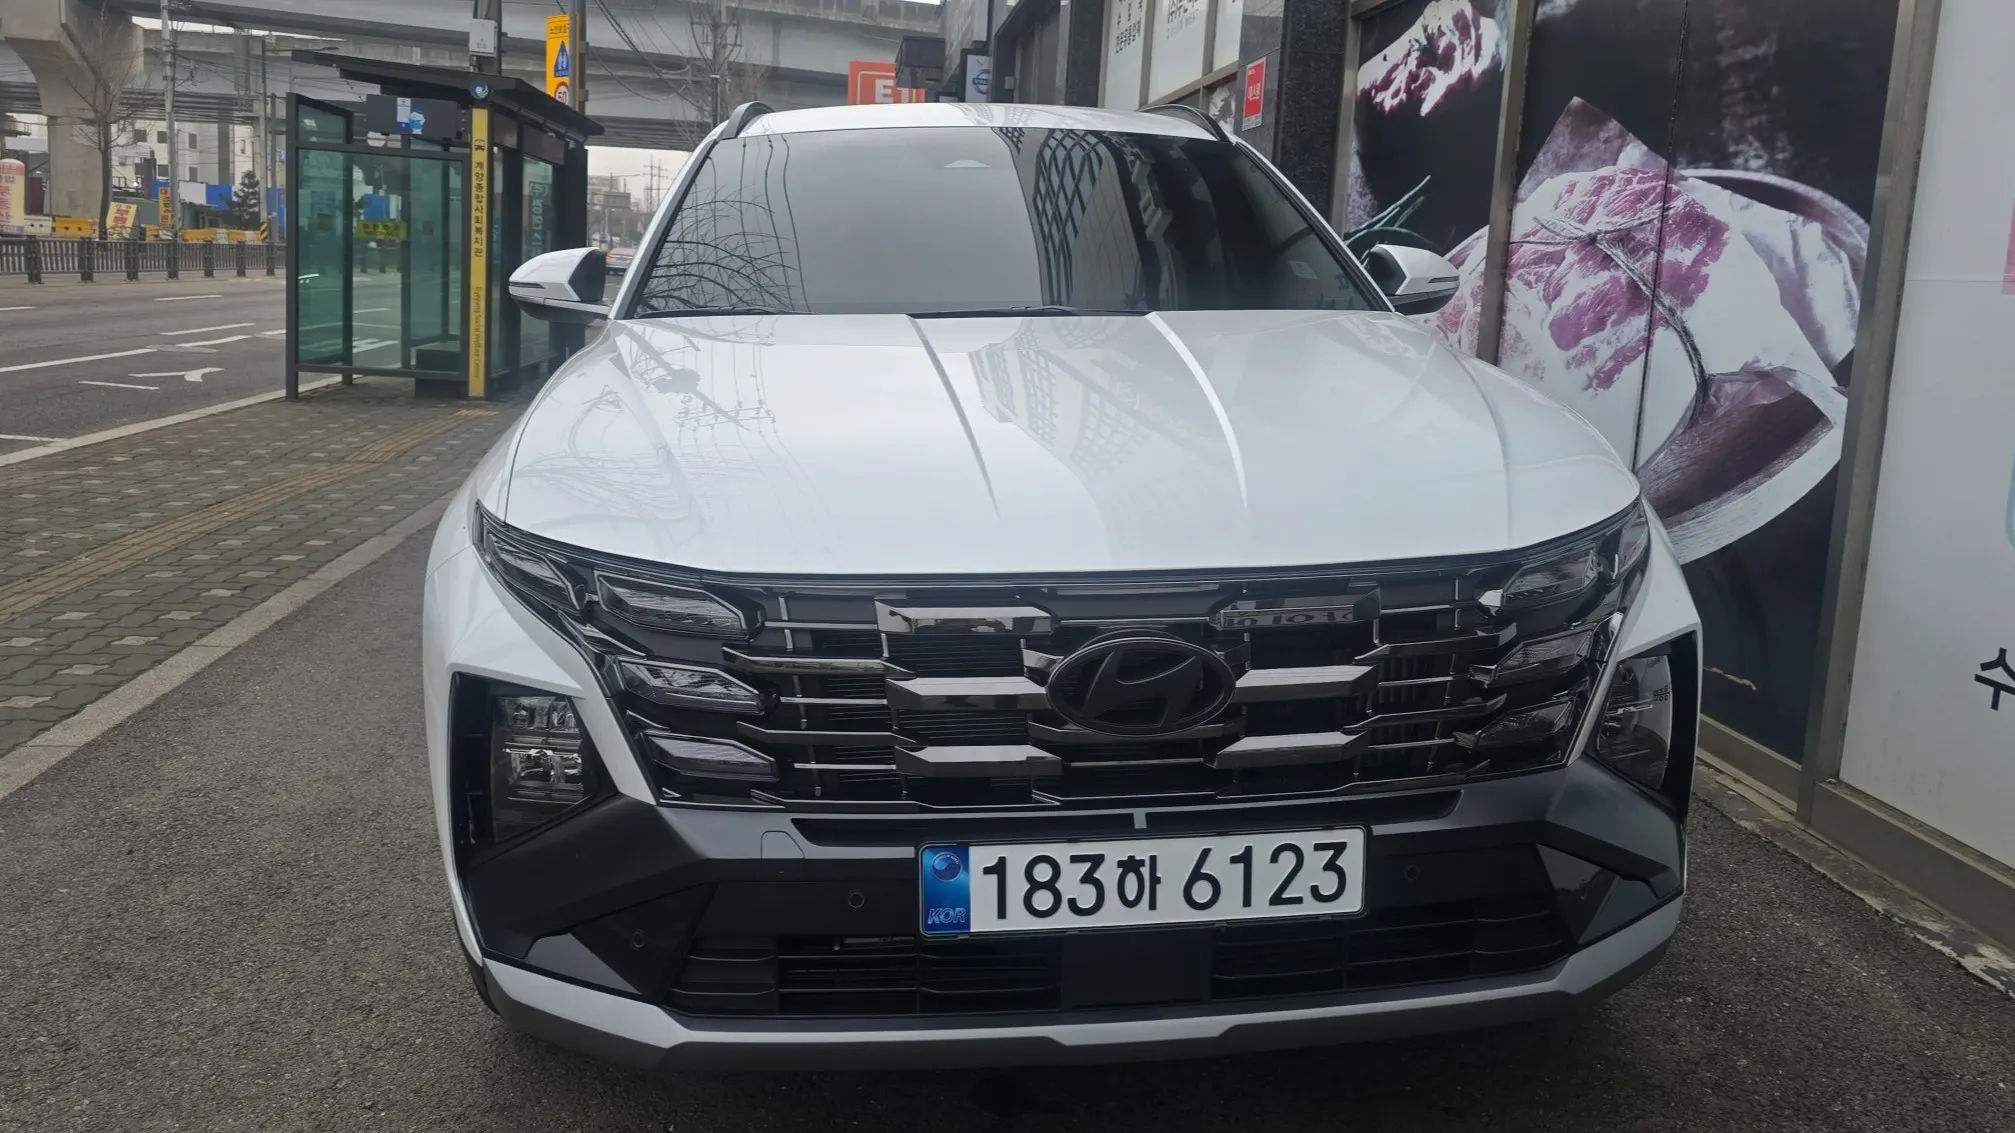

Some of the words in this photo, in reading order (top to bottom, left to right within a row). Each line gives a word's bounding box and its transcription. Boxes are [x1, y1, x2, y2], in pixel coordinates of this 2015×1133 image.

[982, 852, 1162, 920] 183하
[1182, 841, 1349, 911] 6123
[928, 907, 967, 924] KOR
